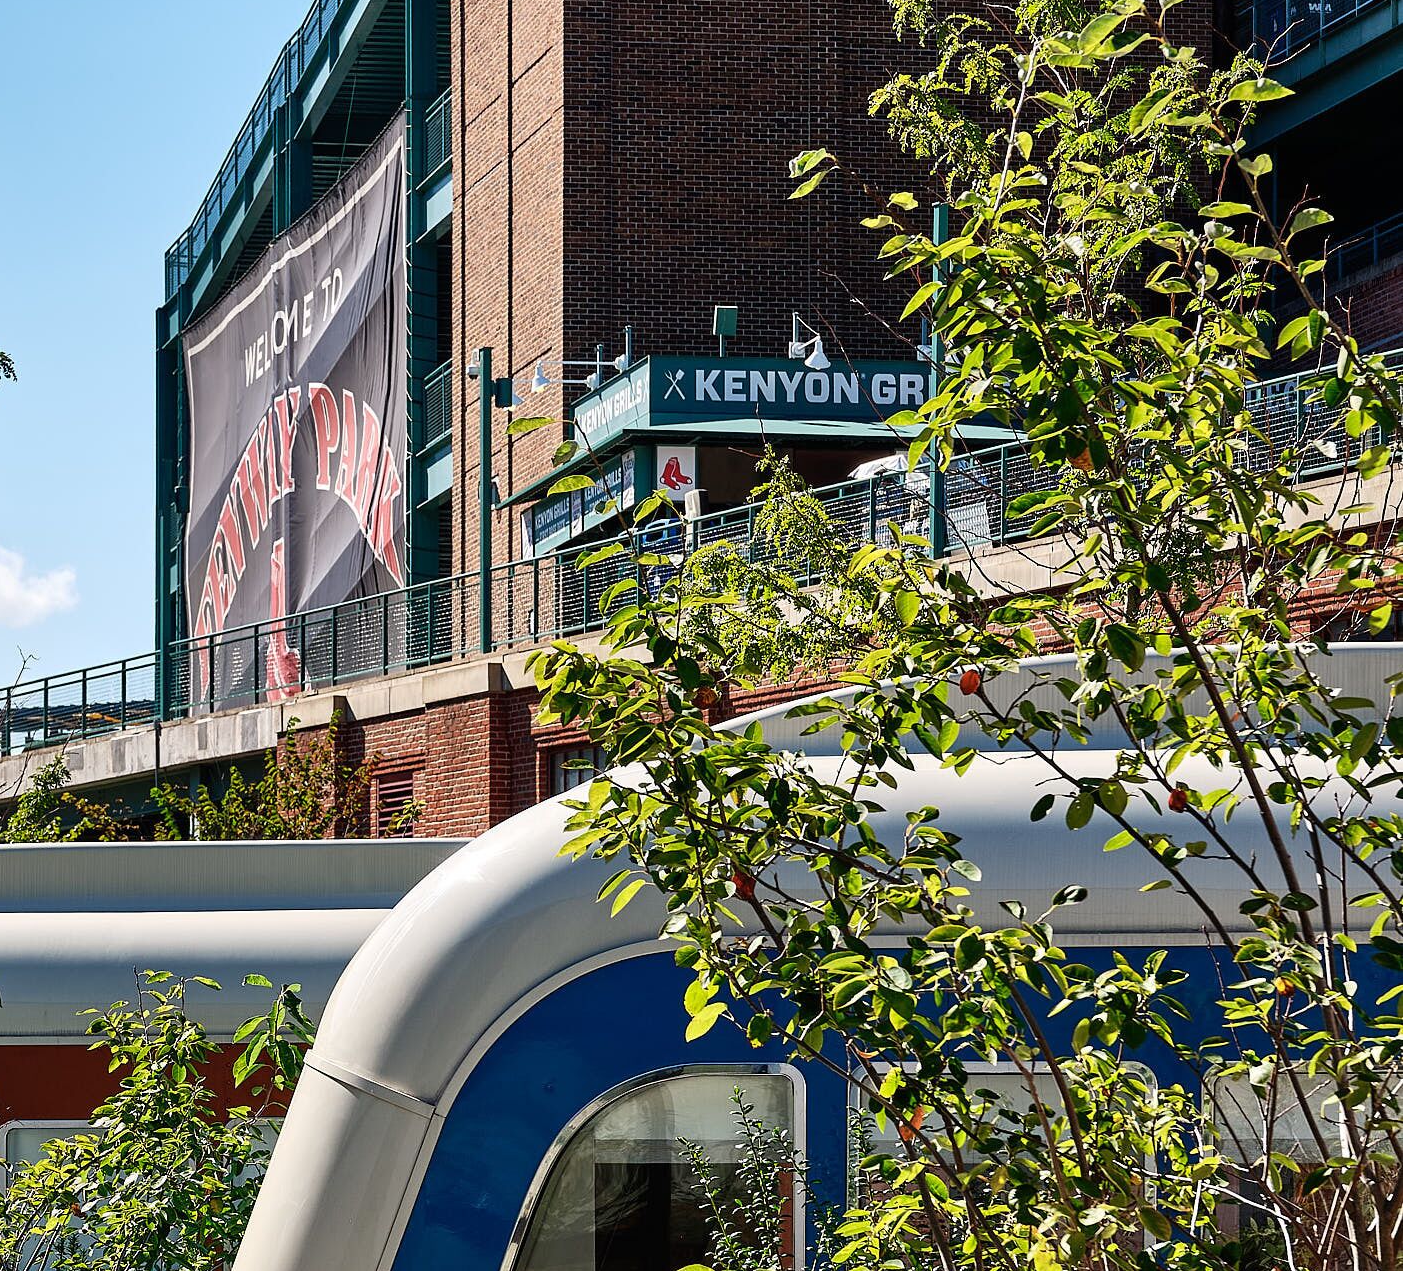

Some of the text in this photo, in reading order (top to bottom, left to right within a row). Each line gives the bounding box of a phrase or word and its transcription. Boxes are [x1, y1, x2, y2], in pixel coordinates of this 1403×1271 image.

[245, 267, 343, 388] WELOME TO
[581, 379, 644, 435] KENYON GRILLS
[695, 369, 860, 405] KENYON
[308, 382, 405, 589] PARK
